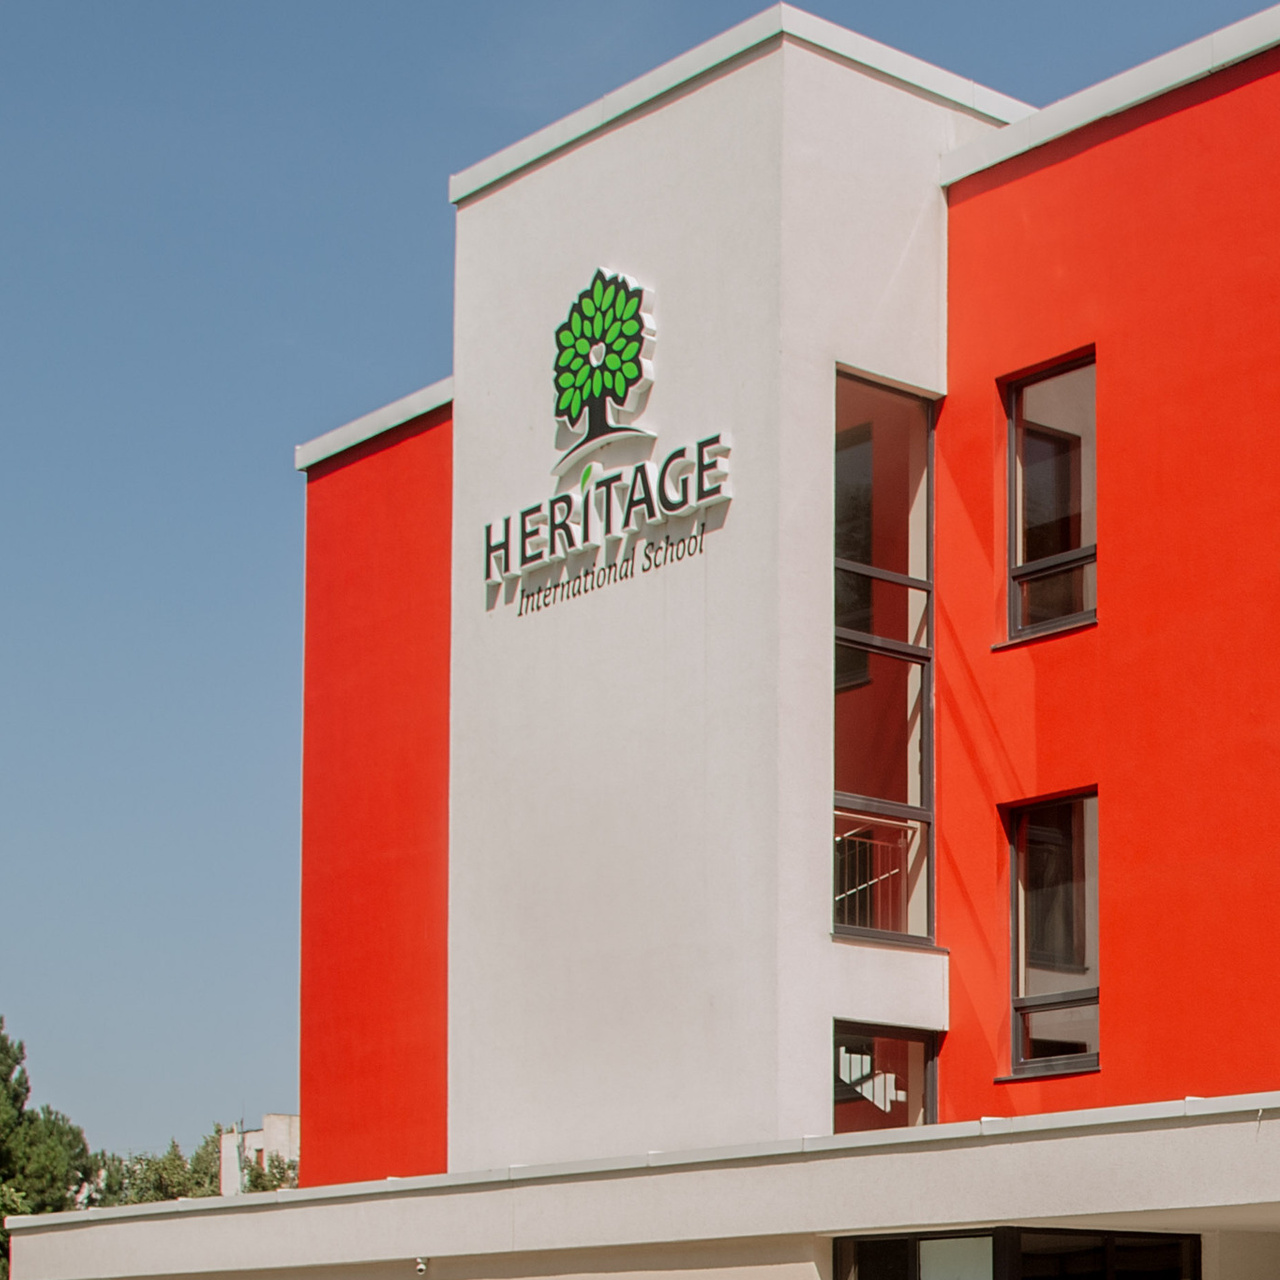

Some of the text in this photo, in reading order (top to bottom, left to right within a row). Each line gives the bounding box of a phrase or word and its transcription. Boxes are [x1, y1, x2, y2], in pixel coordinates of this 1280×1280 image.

[484, 434, 723, 581] HERITAGE
[518, 524, 706, 617] International School
